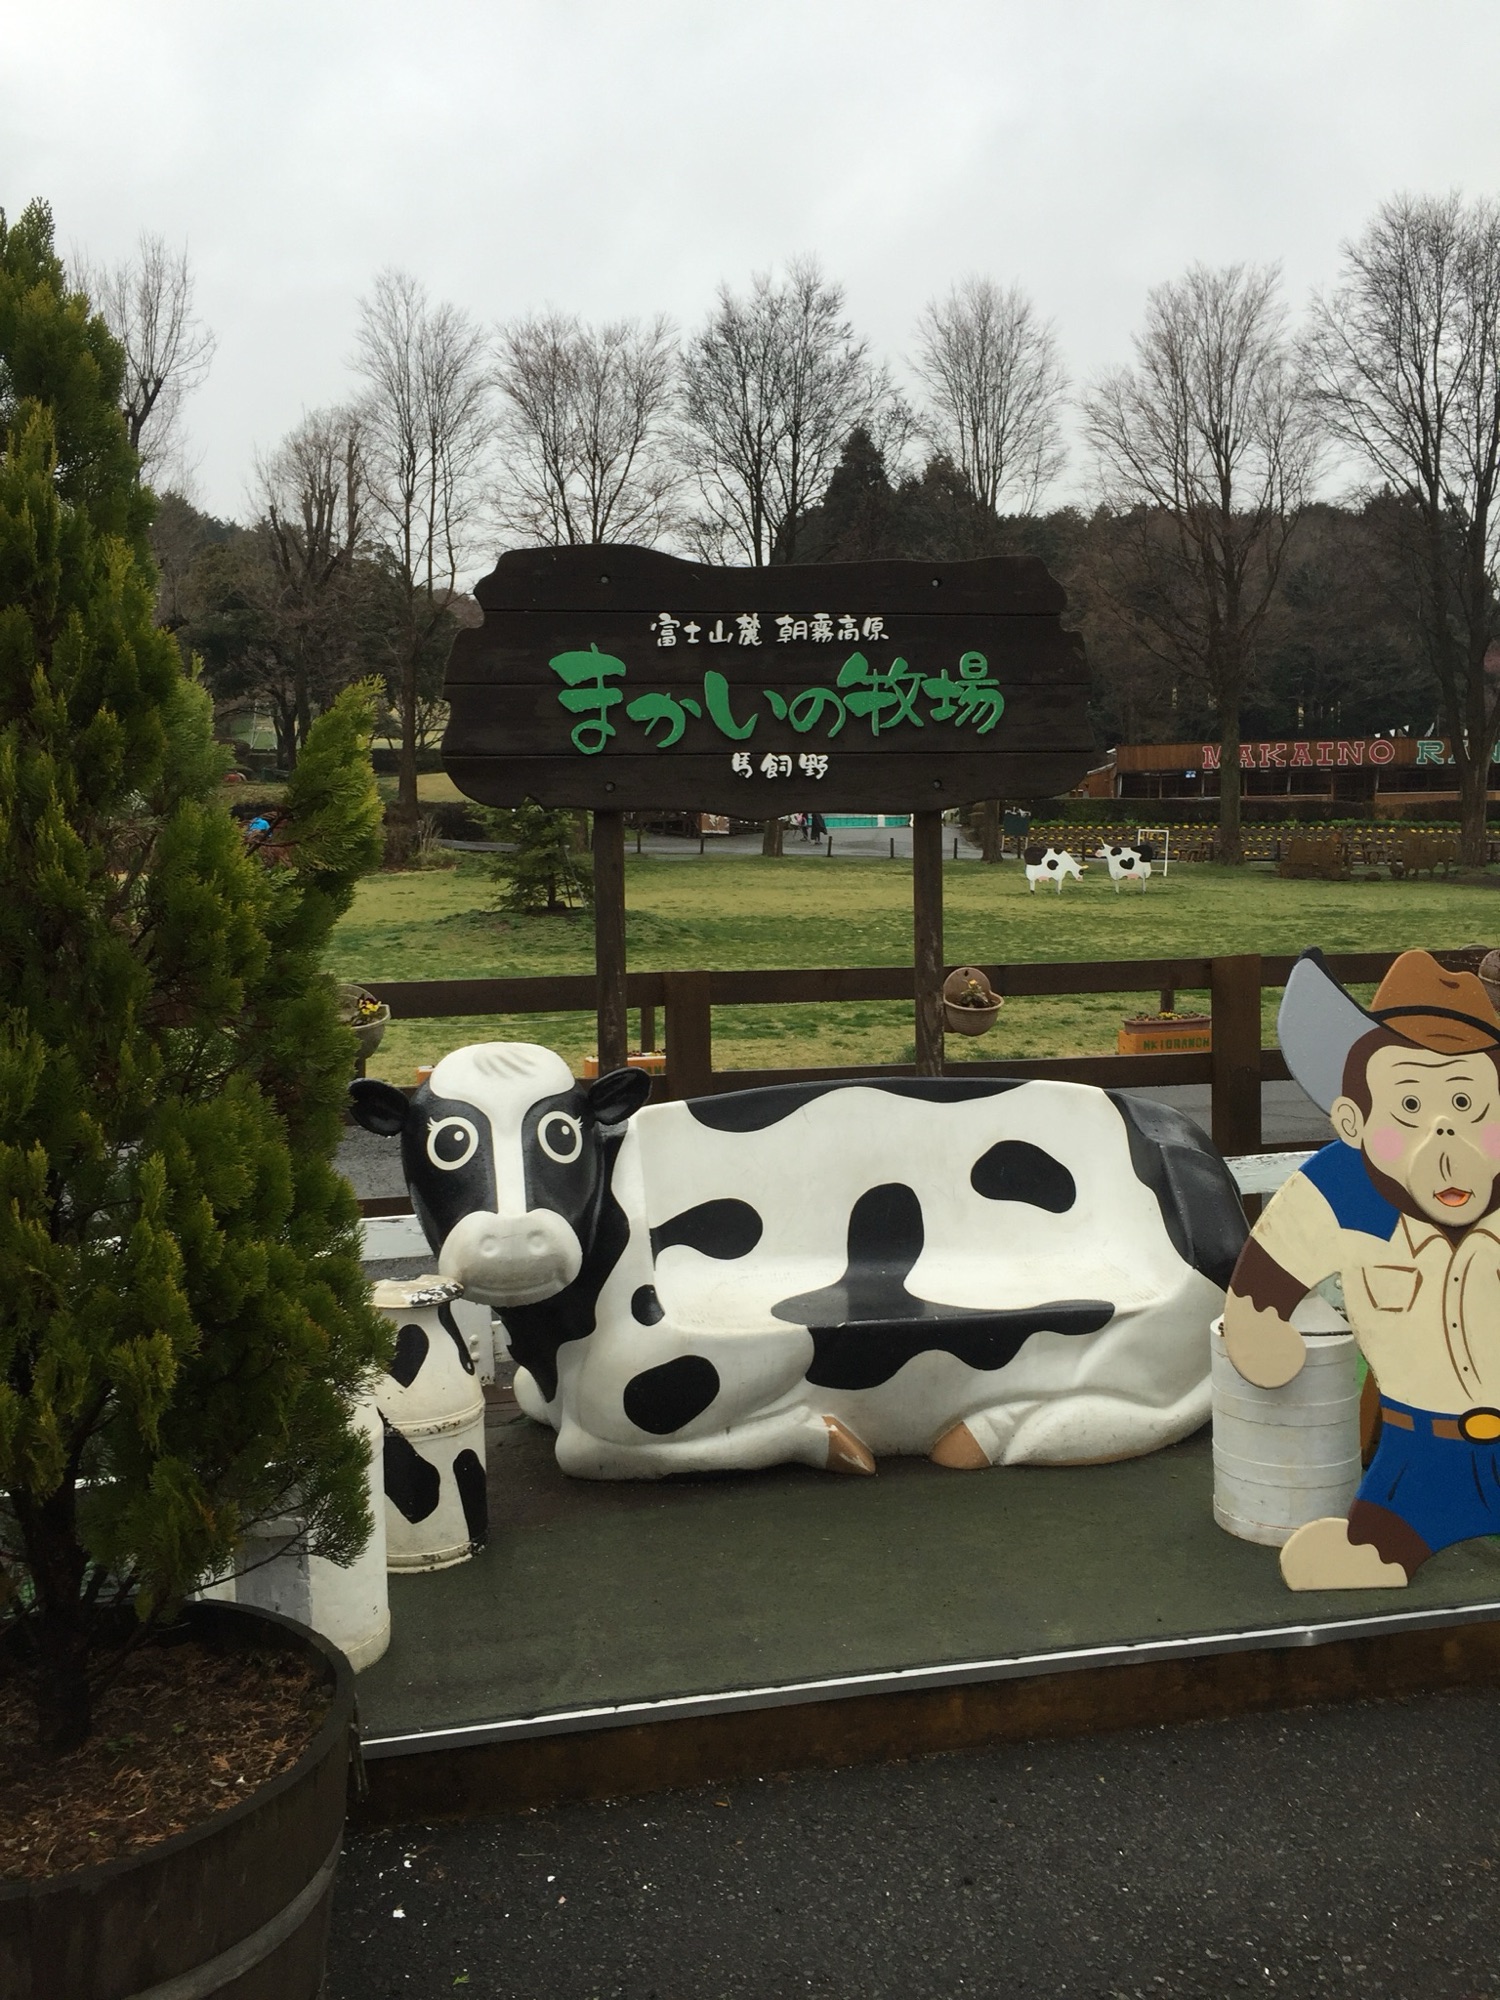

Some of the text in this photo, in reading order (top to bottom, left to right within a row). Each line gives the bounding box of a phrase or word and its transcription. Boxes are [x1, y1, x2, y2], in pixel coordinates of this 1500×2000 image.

[651, 612, 889, 647] 富士山麓 朝霧高原
[548, 642, 1005, 755] まかいの牧場
[731, 752, 829, 780] 馬飼野
[1202, 739, 1395, 770] MAKAINO
